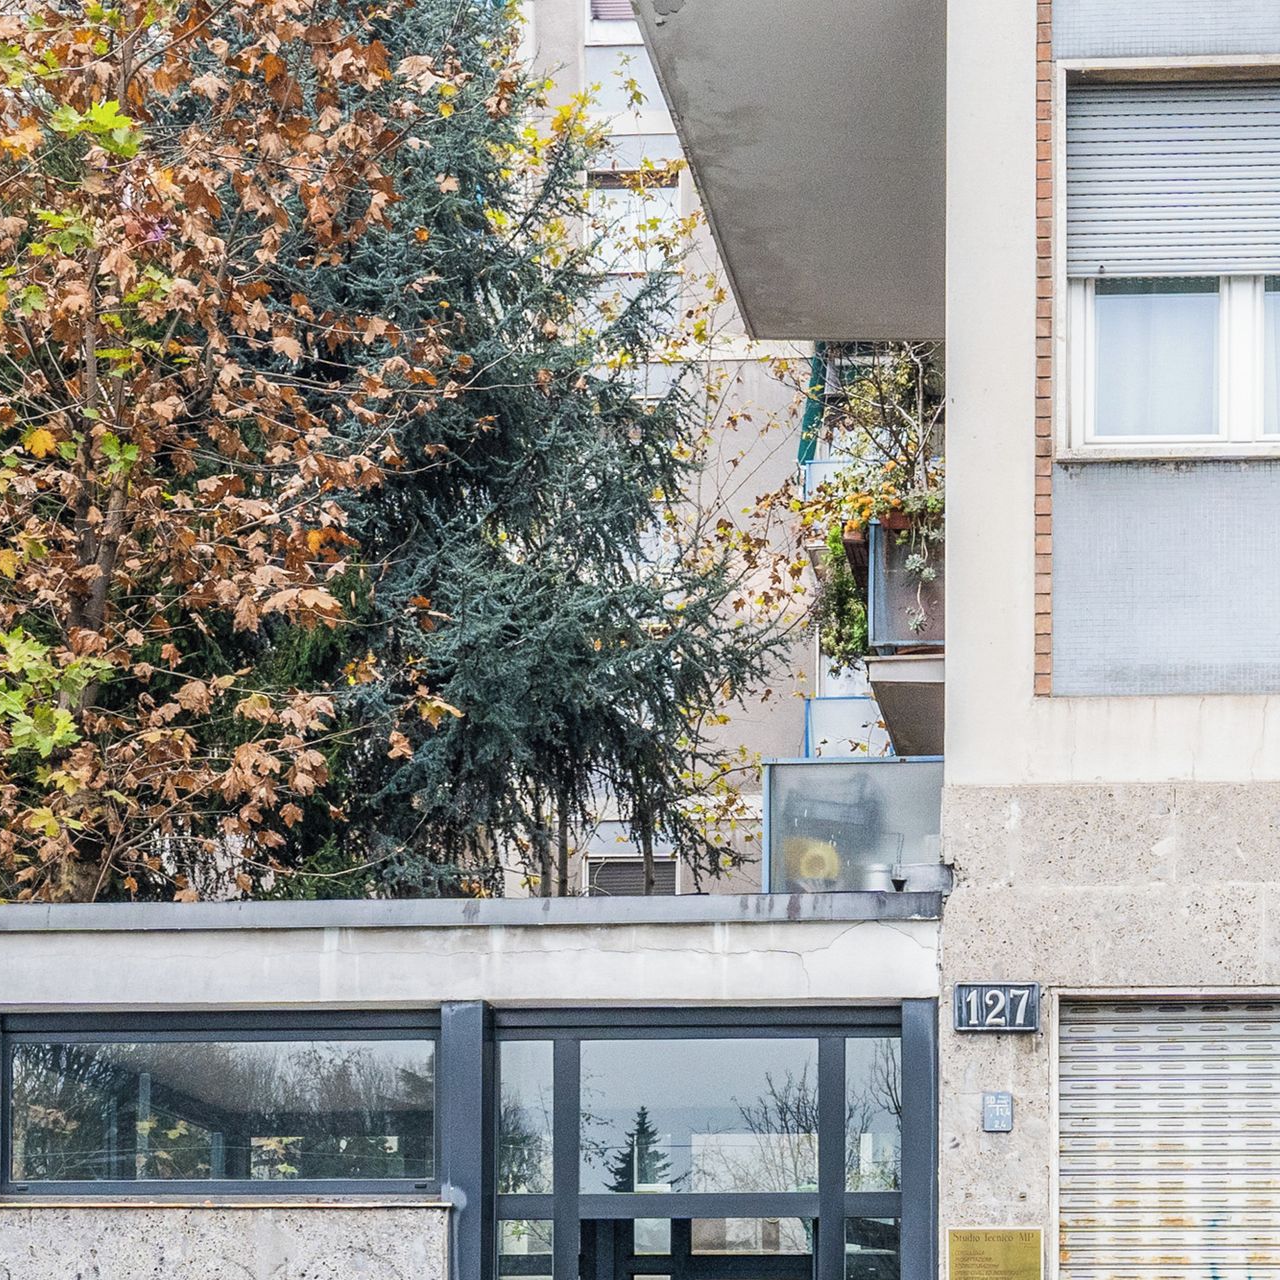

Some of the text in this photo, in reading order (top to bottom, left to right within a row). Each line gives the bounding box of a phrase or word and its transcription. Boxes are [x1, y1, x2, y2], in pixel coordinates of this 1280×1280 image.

[966, 989, 1029, 1026] 127
[953, 1232, 980, 1242] Studio
[984, 1232, 1014, 1242] Tecnico
